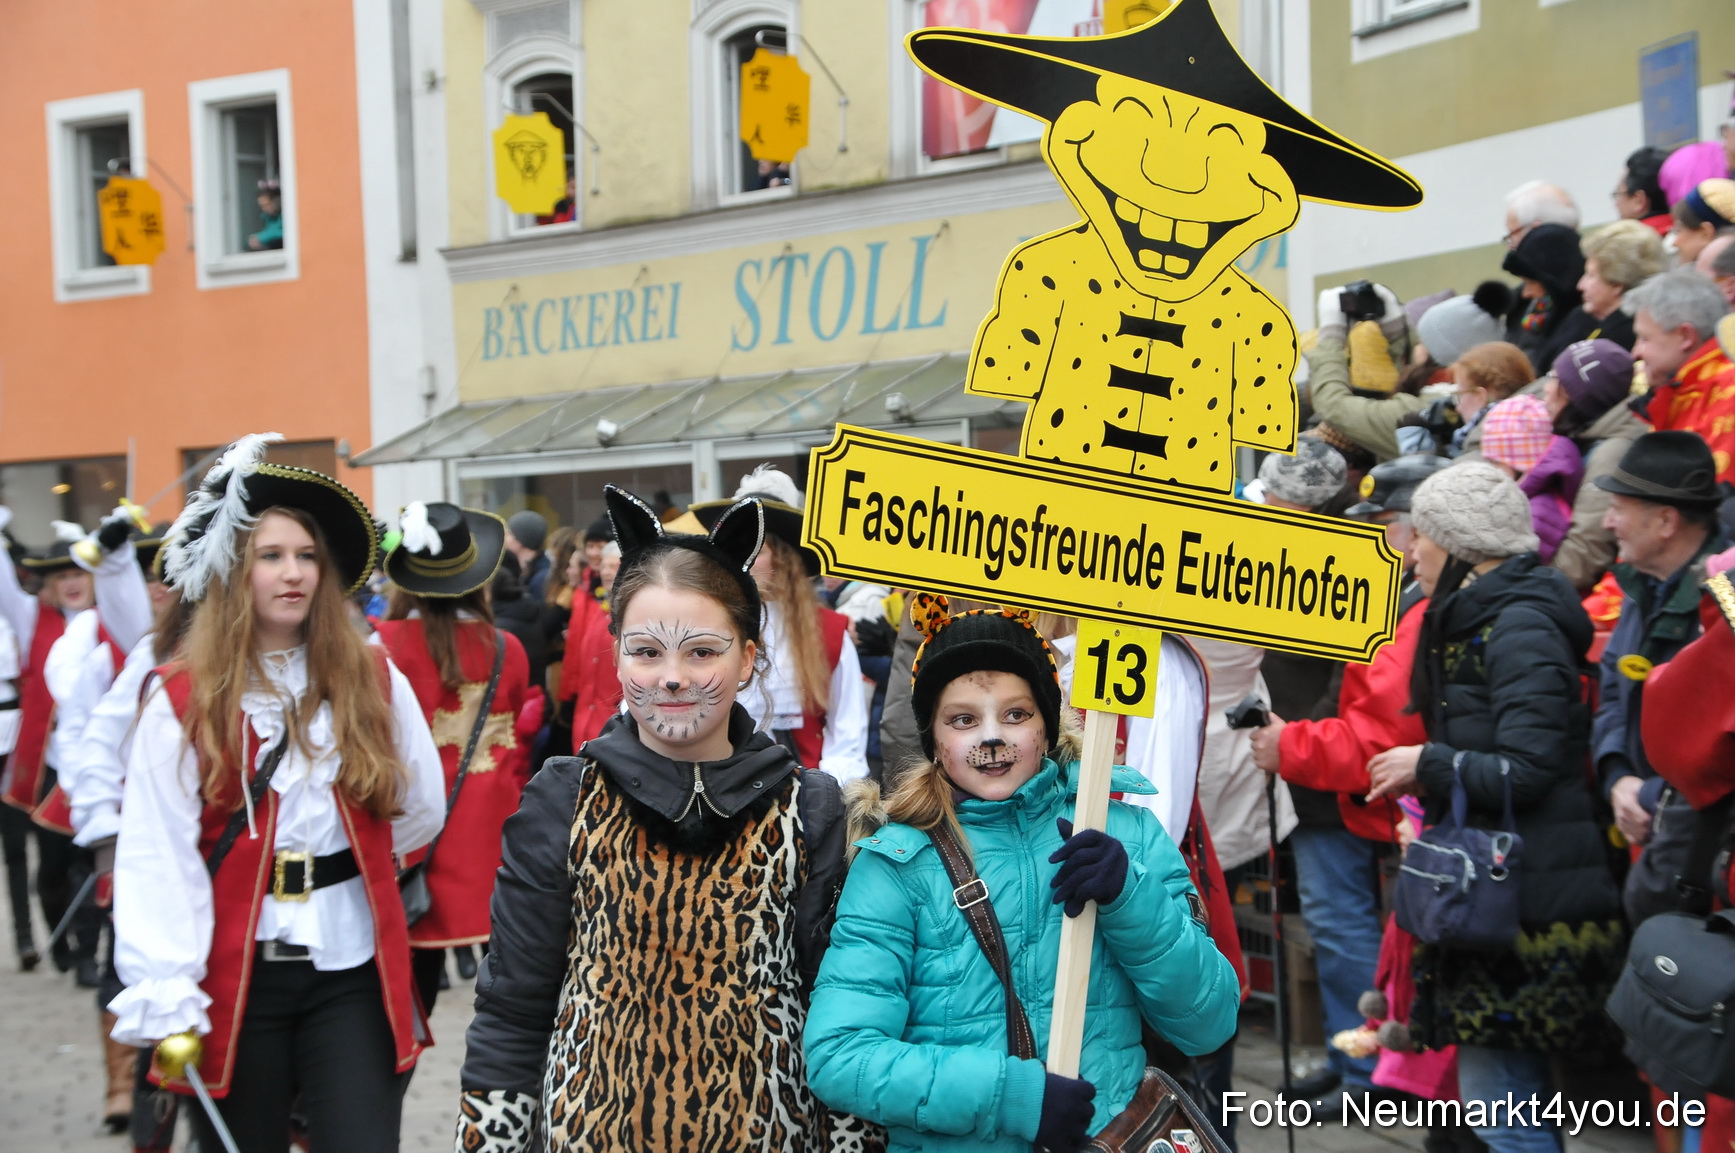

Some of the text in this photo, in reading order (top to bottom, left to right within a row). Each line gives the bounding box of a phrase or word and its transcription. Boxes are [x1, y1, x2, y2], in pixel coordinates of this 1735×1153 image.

[481, 234, 948, 361] BÄCKEREI STOLL
[839, 469, 1371, 624] Faschingsfreunde Eutenhofen
[1087, 638, 1148, 706] 13
